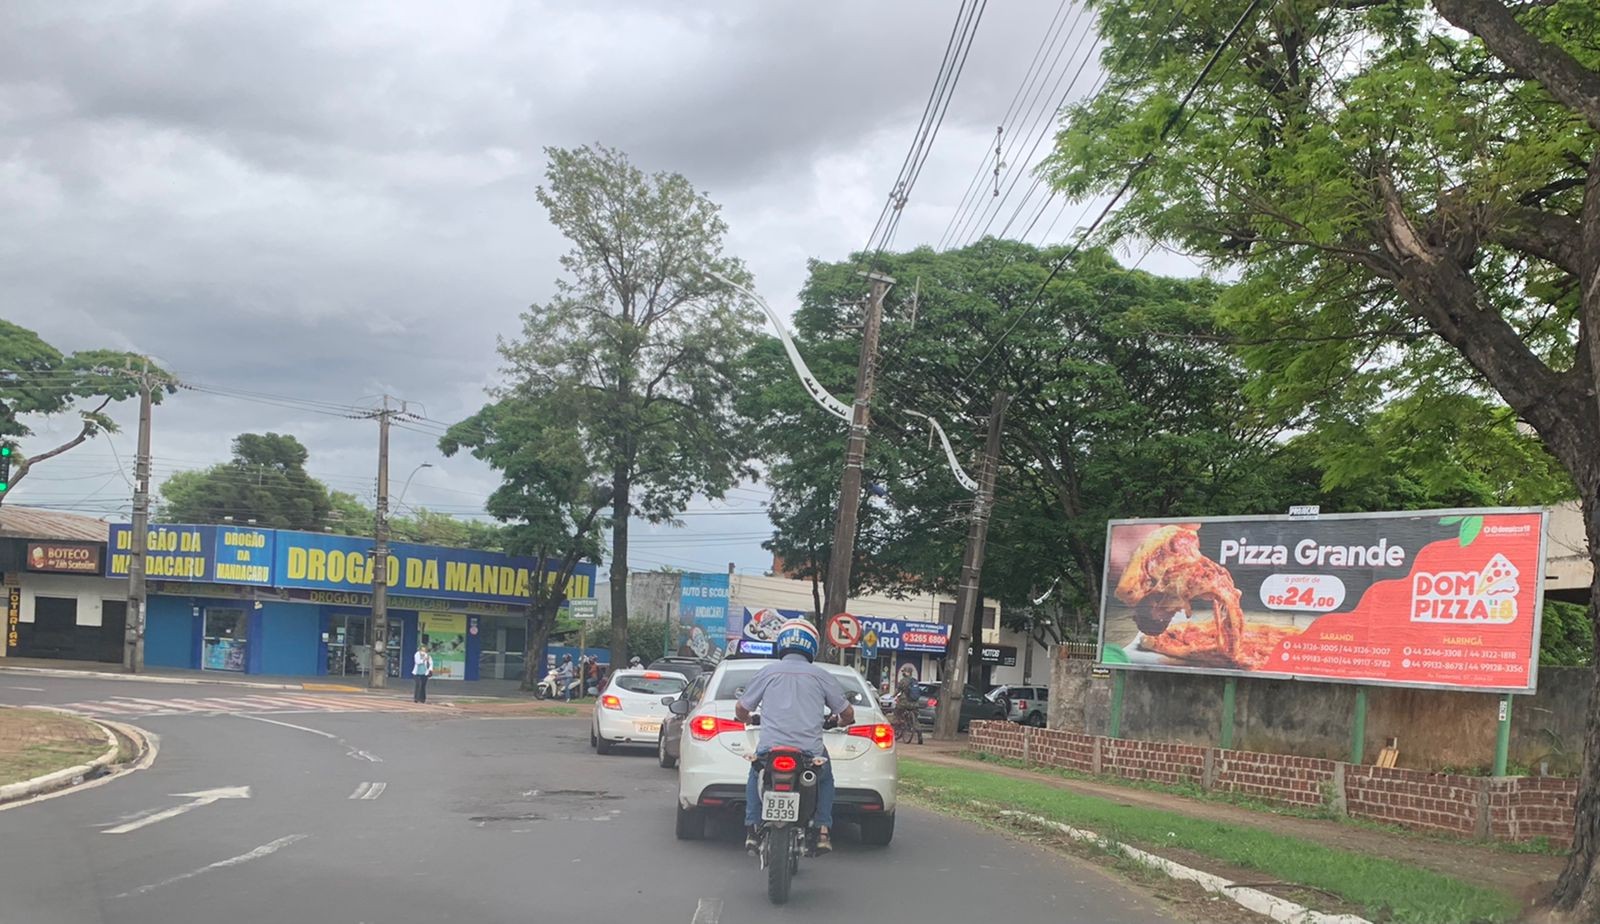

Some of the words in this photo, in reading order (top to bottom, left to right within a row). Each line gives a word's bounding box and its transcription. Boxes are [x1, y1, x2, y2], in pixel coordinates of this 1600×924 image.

[117, 528, 177, 551] DGÃO
[181, 532, 201, 552] DA
[224, 530, 265, 547] DROGÃO
[48, 547, 89, 560] BOTECO
[236, 550, 250, 561] DA
[1219, 537, 1288, 565] Pizza
[1294, 538, 1405, 567] Grande
[112, 554, 205, 577] MDACARU
[216, 563, 269, 582] MANDACARU
[405, 557, 439, 589] DA
[682, 587, 700, 597] AUTO
[1416, 575, 1475, 596] DOM
[1414, 599, 1488, 620] PIZZA
[909, 633, 927, 642] 3265
[928, 635, 946, 645] 6800
[1319, 632, 1354, 641] SARANDI
[766, 808, 795, 820] 6339
